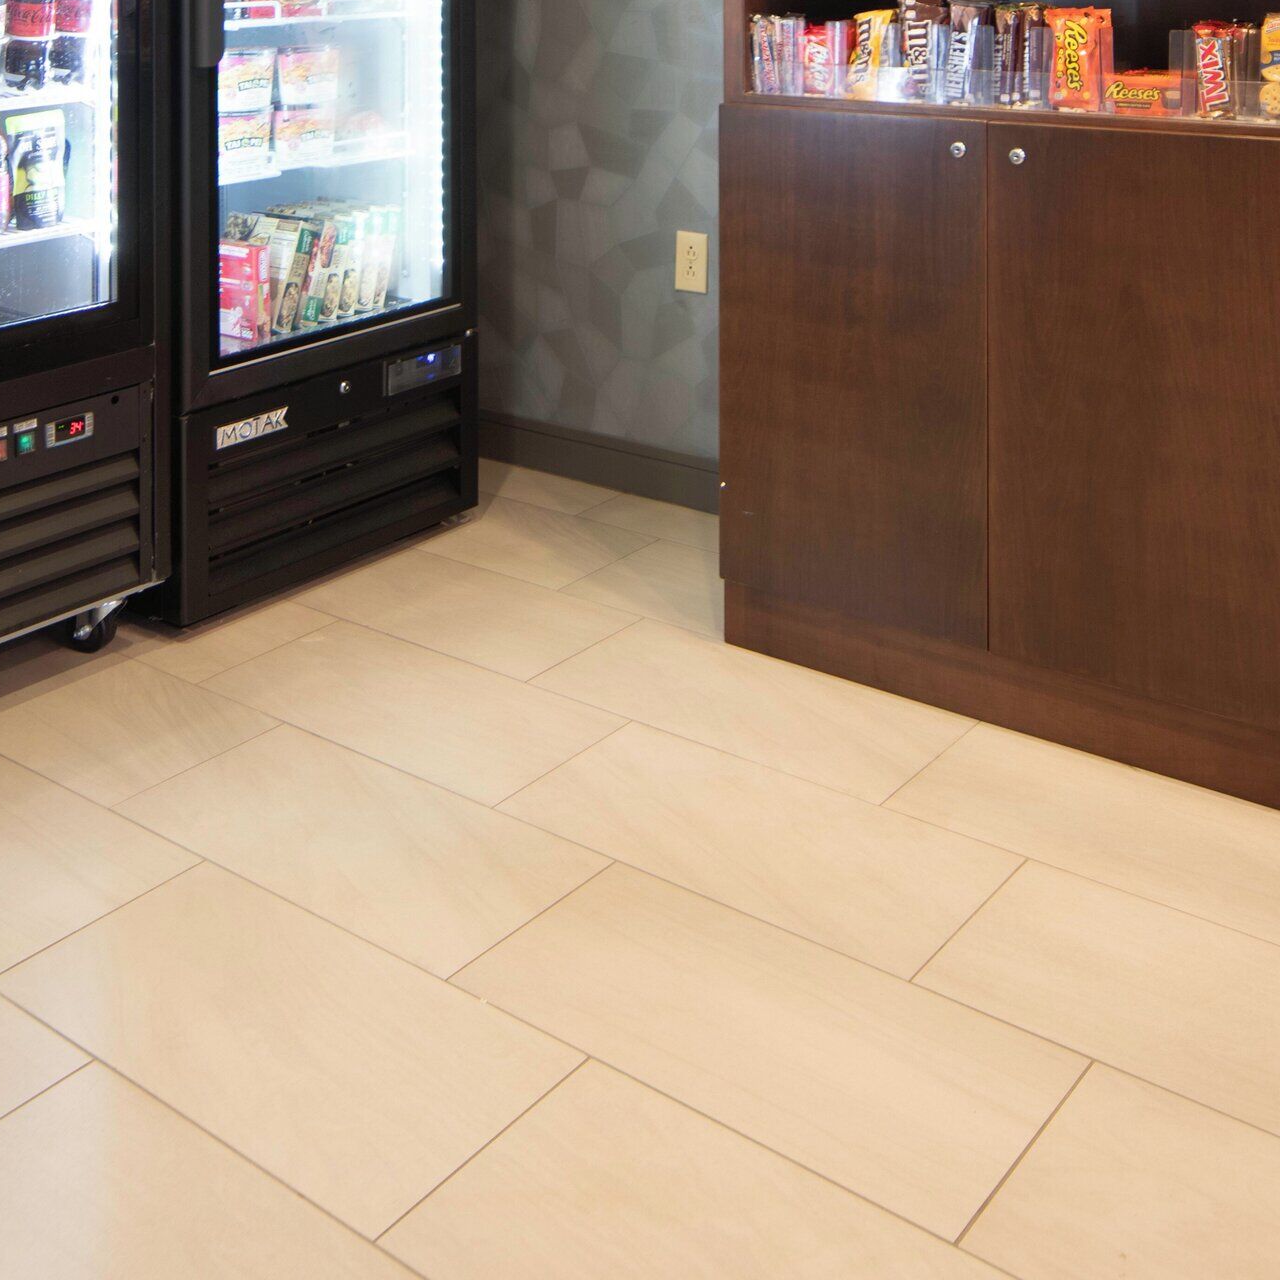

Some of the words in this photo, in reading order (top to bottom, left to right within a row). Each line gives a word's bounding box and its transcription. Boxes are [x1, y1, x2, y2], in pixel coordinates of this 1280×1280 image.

[1064, 19, 1088, 92] Reese's
[1200, 40, 1229, 112] TWIX
[1105, 80, 1160, 100] Reese's
[220, 409, 285, 446] MOTAK
